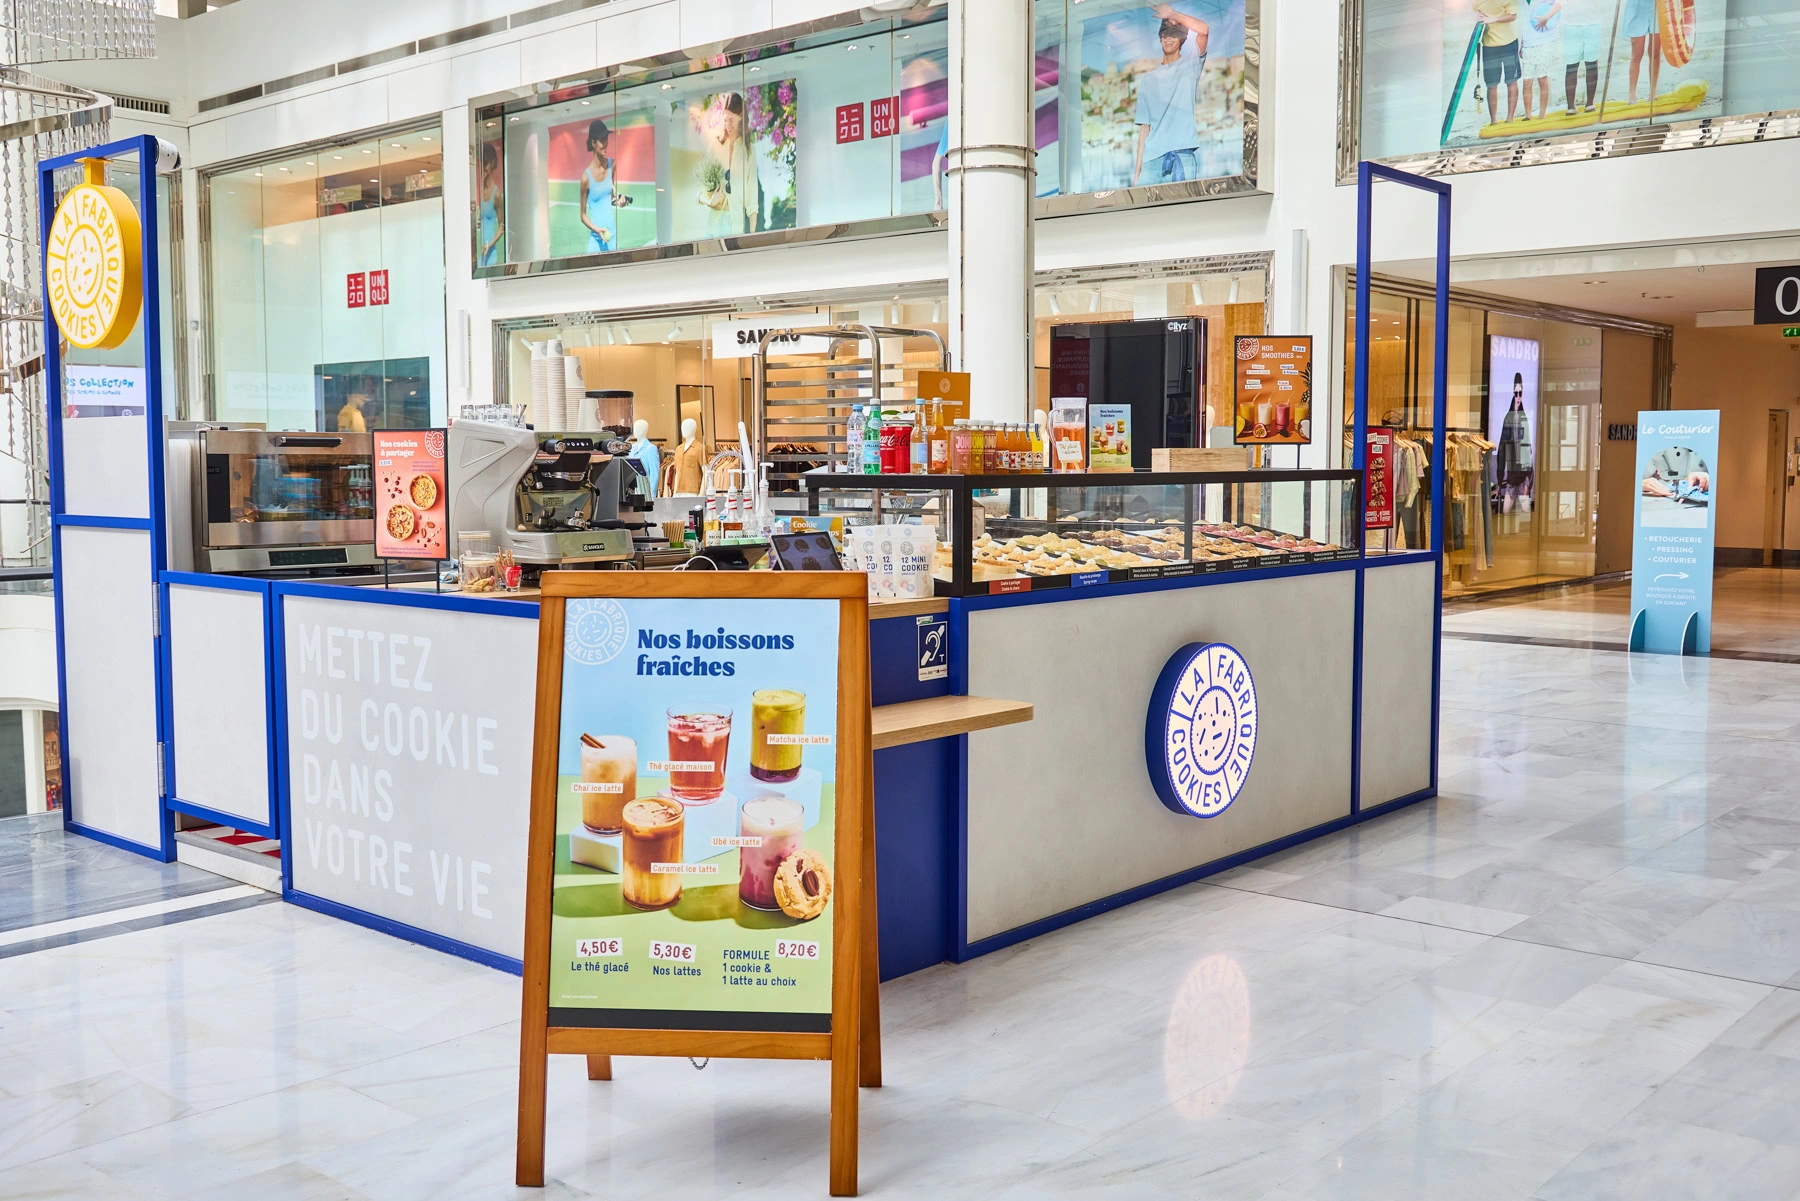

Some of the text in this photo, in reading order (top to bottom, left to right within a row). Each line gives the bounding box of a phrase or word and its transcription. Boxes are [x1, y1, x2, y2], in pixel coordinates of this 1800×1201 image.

[55, 195, 119, 314] LA FABRIQUE
[371, 275, 386, 288] UNI
[371, 287, 387, 303] QLO
[51, 267, 97, 339] COOKIES
[1491, 337, 1539, 361] SANDRO
[79, 377, 134, 388] COLLECTION
[1642, 423, 1714, 435] Le Couturier
[380, 439, 418, 448] Nos cookies
[380, 448, 415, 458] à partager
[792, 520, 817, 529] Cookie
[1652, 556, 1697, 564] COUTURIER
[568, 599, 625, 651] LA FABRIQUE
[637, 626, 795, 650] Nos boissons
[298, 622, 433, 692] METTEZ
[939, 654, 944, 662] T
[636, 654, 735, 677] fraîches
[1181, 654, 1252, 782] LA FABRIQUE
[301, 688, 499, 776] DU COOKIE
[769, 736, 829, 744] Matcha ice latte
[649, 762, 713, 772] Thé glacé maison
[1172, 728, 1223, 807] COOKIES
[303, 754, 394, 823] DANS
[573, 784, 622, 792] Chaï ice latte
[712, 838, 760, 847] Ubé ice latte
[305, 817, 493, 920] VOTRE VIE
[652, 864, 717, 873] Caramel ice latte
[580, 940, 619, 955] 4,50€
[653, 943, 692, 960] 5,30€
[778, 942, 817, 958] 8,20€
[723, 949, 770, 960] FORMULE
[571, 962, 629, 974] Le thé glacé
[653, 966, 702, 976] Nos lattes
[722, 962, 772, 973] 1 cookie &
[722, 975, 797, 987] 1 latte au choix
